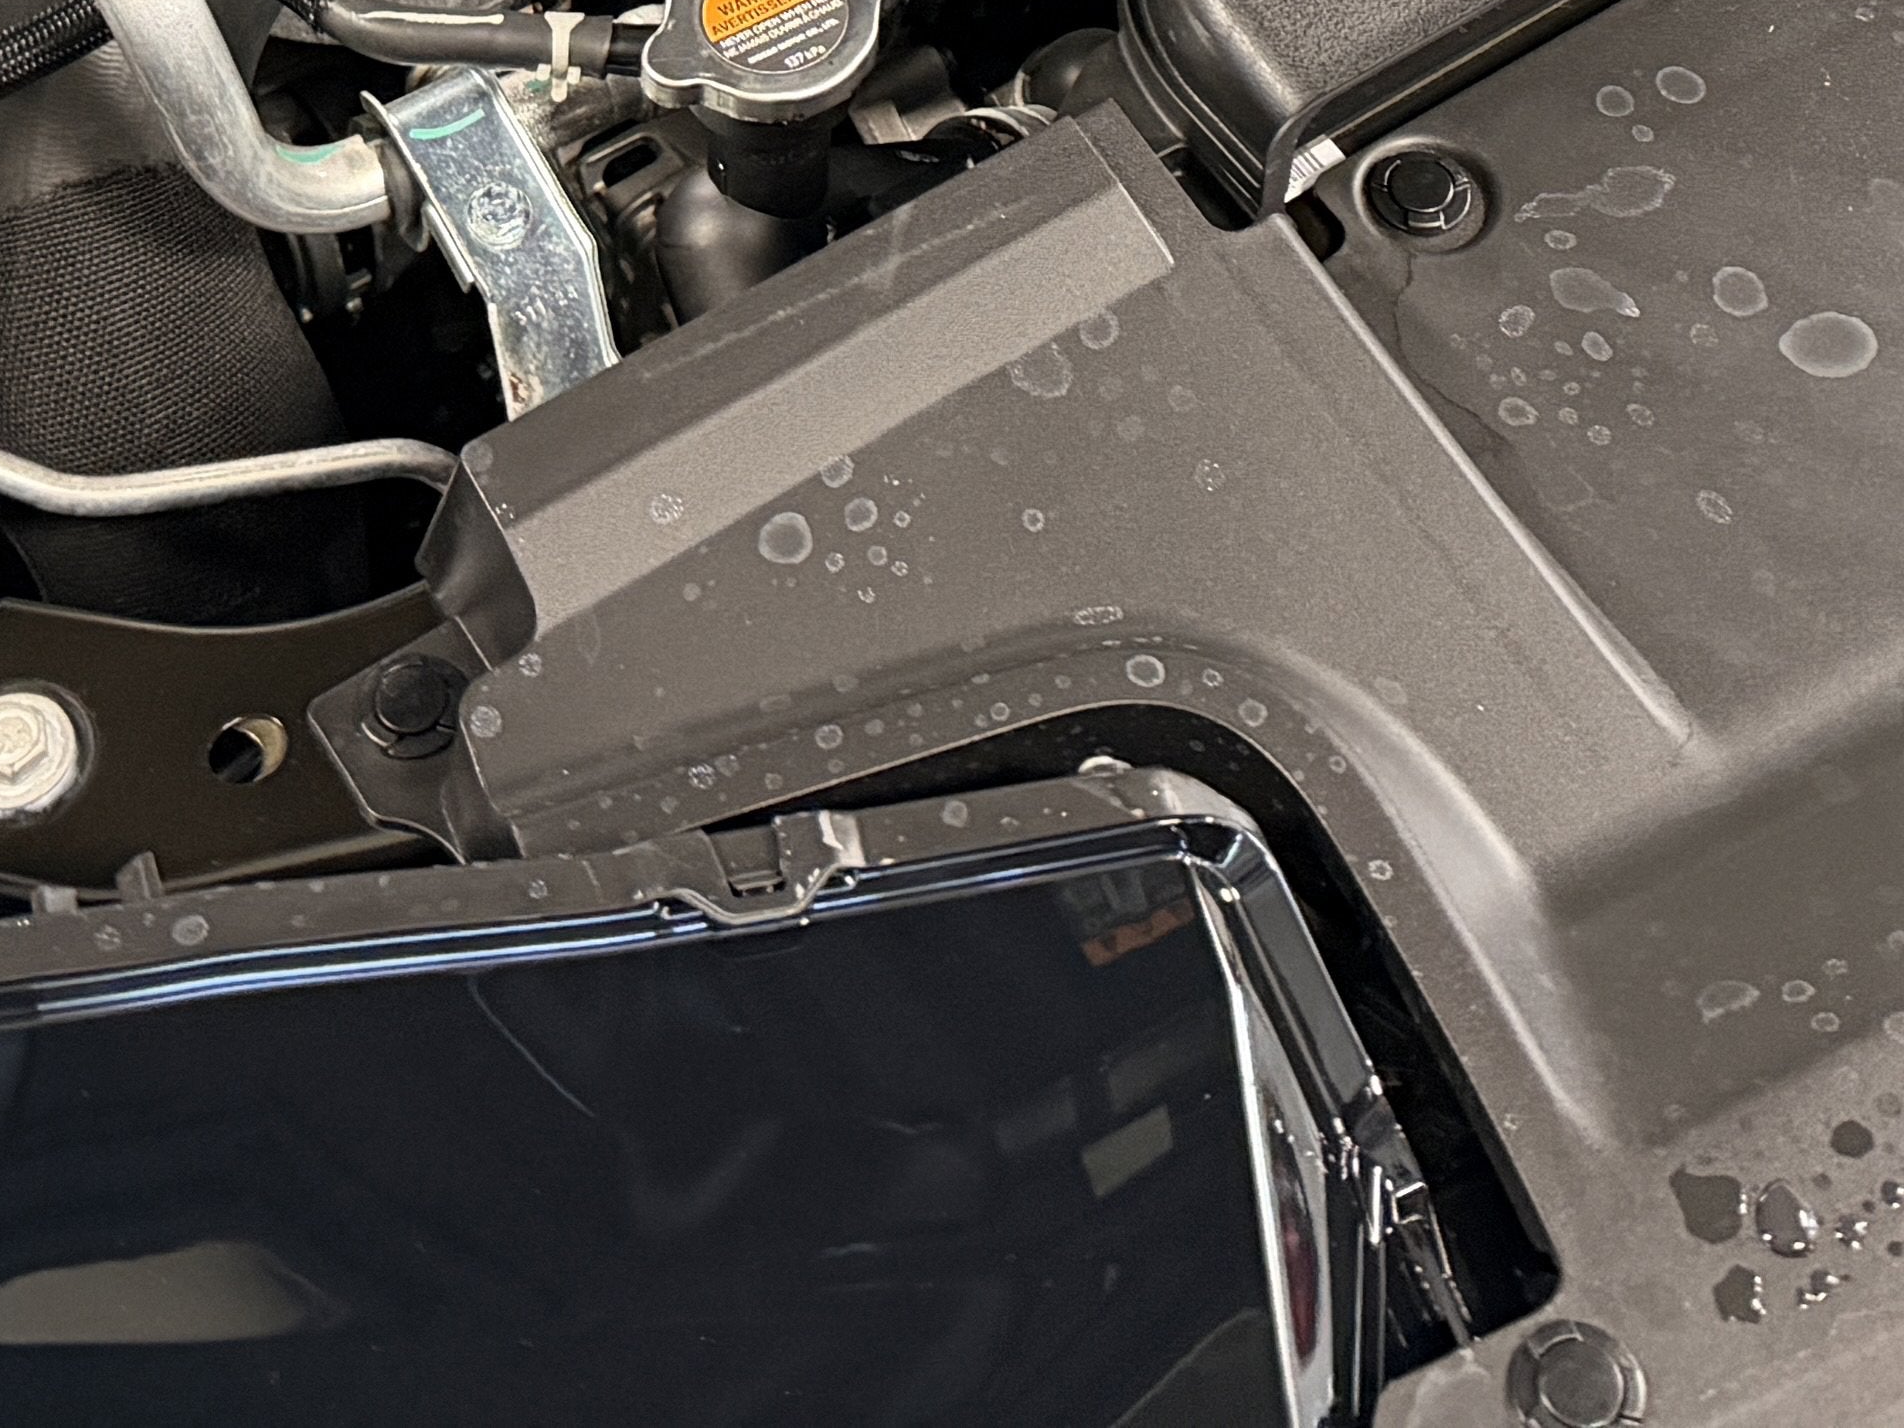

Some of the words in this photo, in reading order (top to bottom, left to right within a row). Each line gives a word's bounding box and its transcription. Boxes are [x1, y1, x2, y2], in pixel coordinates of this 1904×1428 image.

[719, 27, 754, 49] NEVER
[753, 15, 782, 34] OPEN
[780, 0, 812, 22] WHEN
